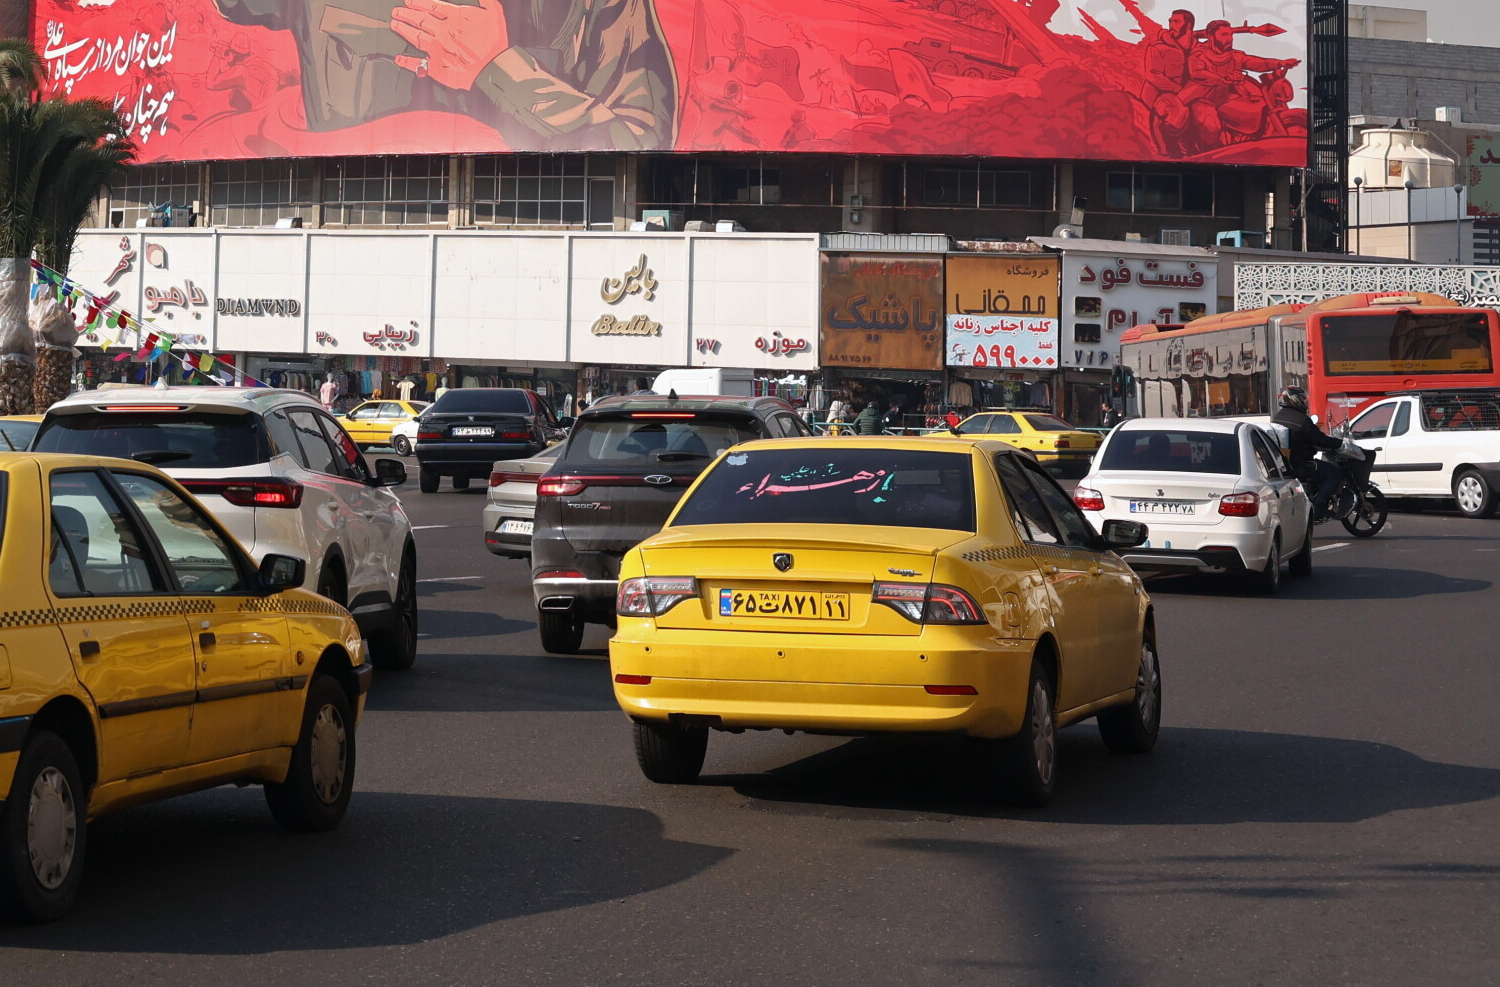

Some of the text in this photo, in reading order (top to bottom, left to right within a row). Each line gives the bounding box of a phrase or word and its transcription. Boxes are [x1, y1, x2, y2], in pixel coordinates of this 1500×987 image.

[147, 21, 177, 68] این
[103, 235, 136, 284] شهر
[1007, 265, 1049, 279] فروشگاه
[600, 252, 657, 304] بالین
[1079, 258, 1205, 291] فست فود
[316, 320, 416, 348] زیبایی ۳۰
[591, 314, 660, 336] Balin
[827, 293, 939, 350] پاشیک
[953, 317, 1052, 336] کلیه اجناس زنانه
[695, 331, 807, 354] موزه ۲۷
[1074, 349, 1109, 365] VIP
[733, 592, 757, 613] ۶۵
[781, 594, 817, 615] ۸۷۱
[825, 600, 845, 618] ۱۱
[759, 593, 780, 601] TAXI
